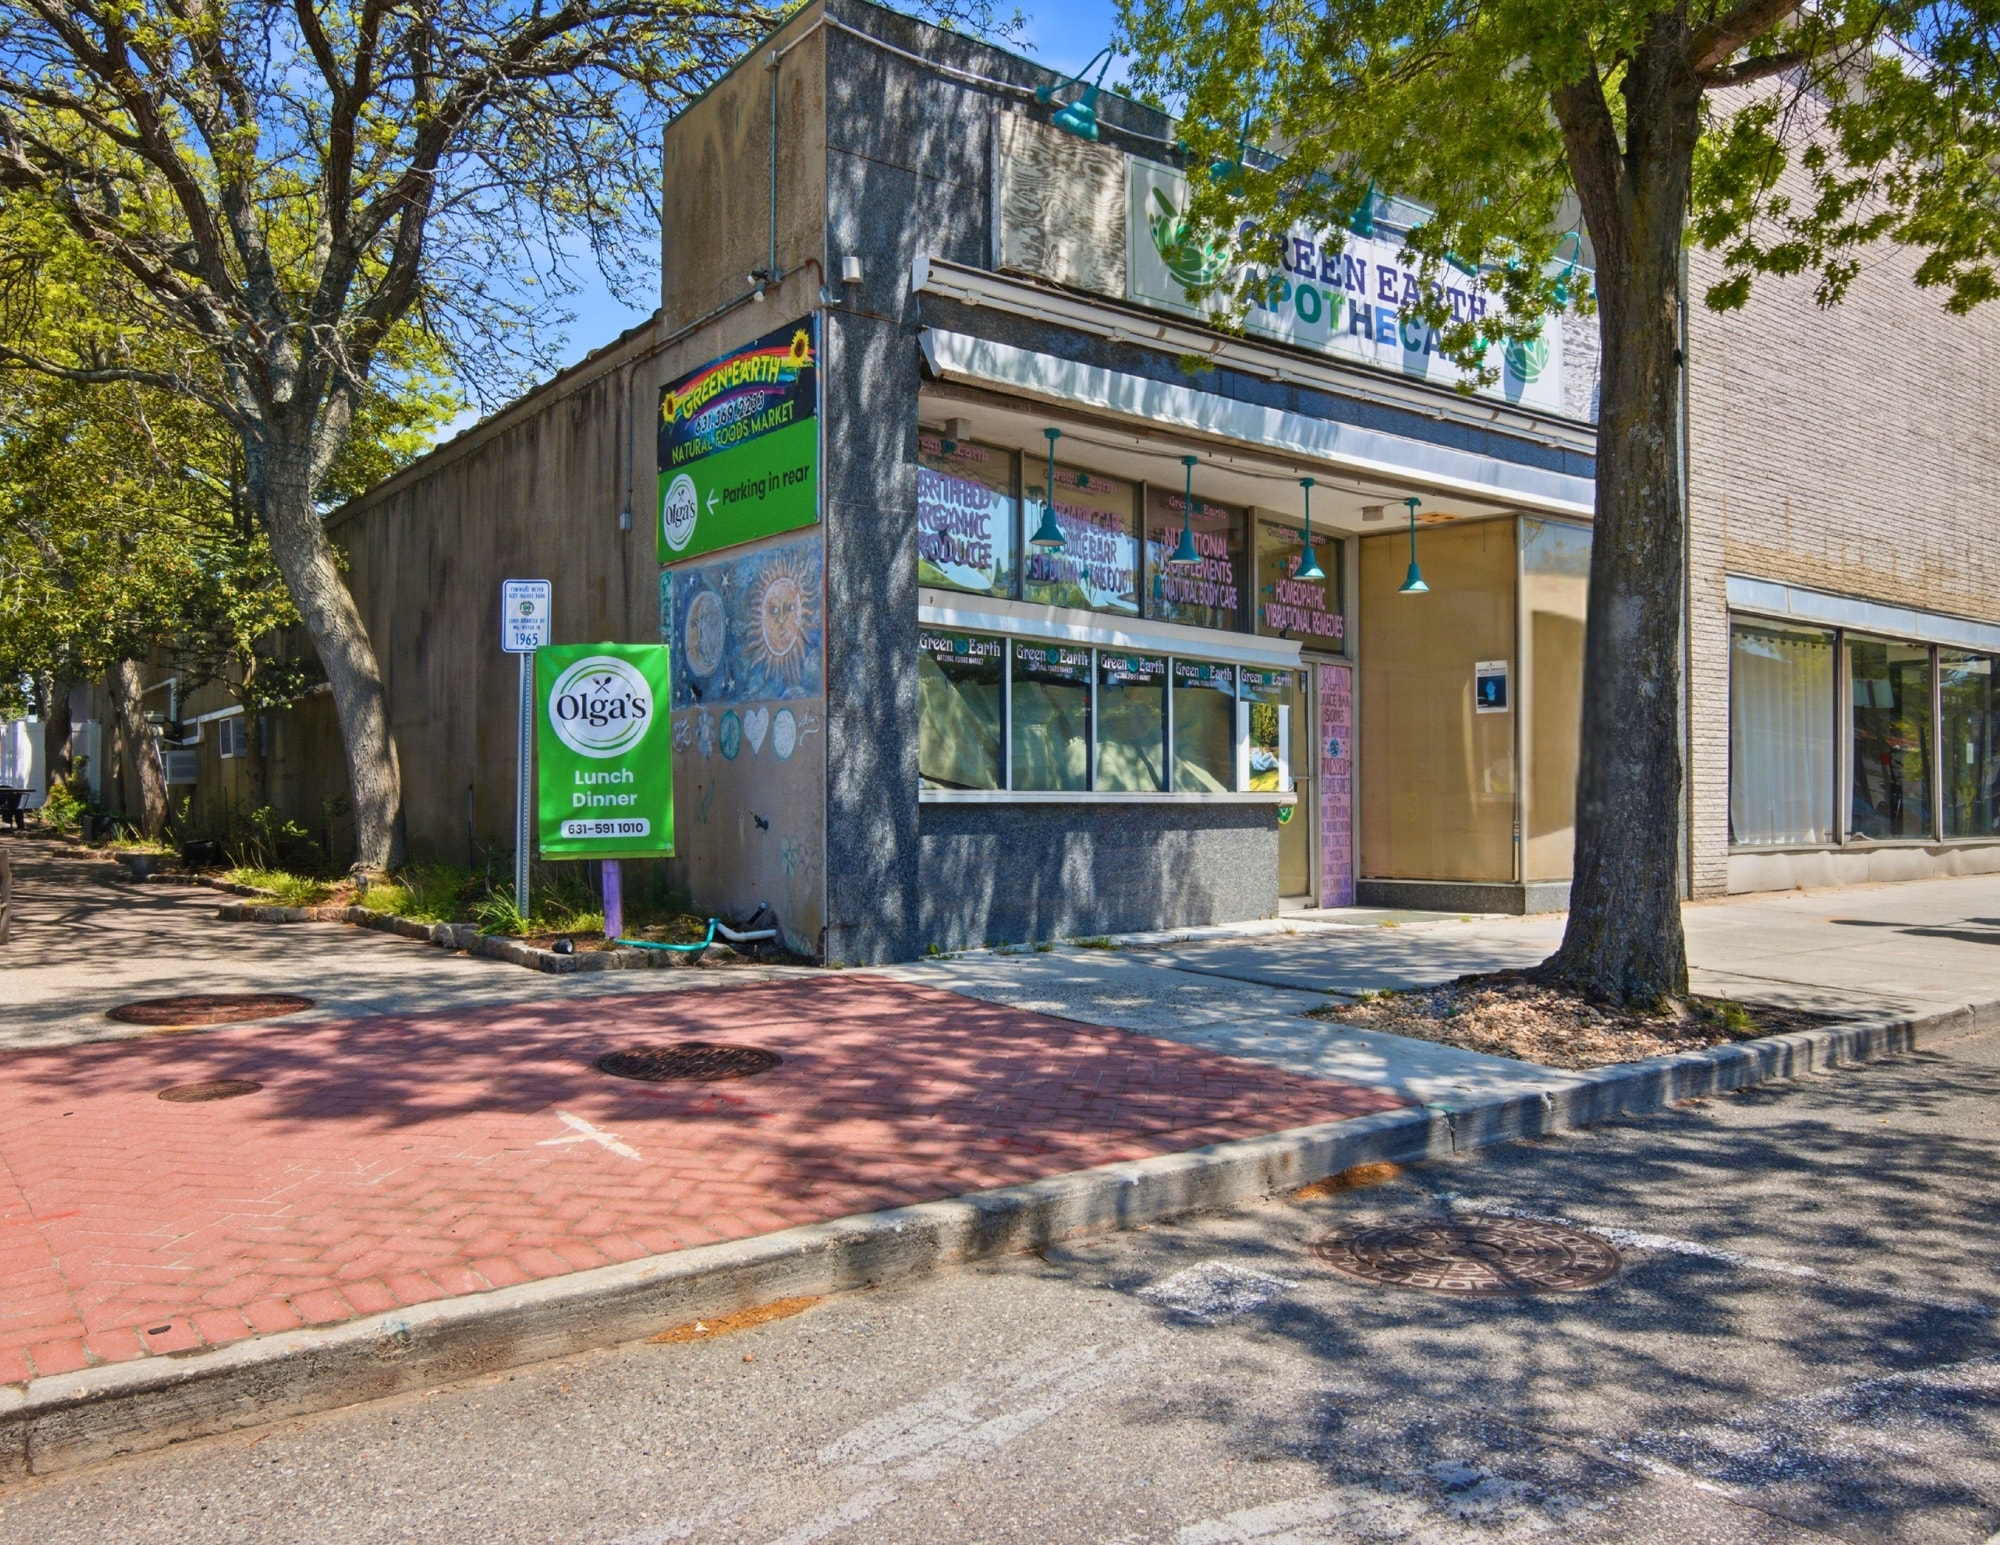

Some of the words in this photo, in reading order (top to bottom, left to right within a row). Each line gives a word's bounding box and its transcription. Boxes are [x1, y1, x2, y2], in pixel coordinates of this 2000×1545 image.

[1242, 268, 1489, 369] APOTHECAY
[681, 364, 731, 419] GREEN
[731, 355, 782, 387] EARTH
[695, 389, 765, 436] 631.369.2233
[672, 431, 713, 464] NATURAL
[715, 422, 750, 448] FOODS
[752, 400, 795, 435] MARKET
[722, 482, 766, 506] Parking
[768, 472, 780, 490] in
[782, 464, 811, 486] rear
[918, 470, 991, 509] ERTIFIED
[665, 500, 696, 527] Olga's
[918, 501, 991, 539] RGANIC
[1052, 500, 1096, 529] RGANIC
[918, 531, 992, 570] RODUCE
[1165, 526, 1228, 560] NUTIONAL
[1200, 582, 1218, 607] BODY
[1219, 586, 1238, 609] CARE
[1276, 579, 1326, 610] HOMEOPATHIC
[1265, 603, 1311, 633] VIBRATIONAL
[1312, 611, 1344, 639] REMEDIES
[515, 633, 538, 646] 1965
[919, 633, 953, 652] Green
[968, 638, 1001, 657] Earth
[1016, 644, 1046, 662] Green
[1059, 648, 1089, 667] Earth
[1101, 654, 1128, 670] Green
[1139, 657, 1165, 675] Earth
[1176, 662, 1200, 678] Green
[1209, 665, 1233, 681] Earth
[1241, 669, 1263, 684] Green
[1272, 672, 1293, 687] Earth
[556, 693, 647, 727] Olga's
[575, 768, 634, 785] Lunch
[1321, 758, 1351, 776] TRESSED?
[572, 790, 638, 808] Dinner
[568, 823, 615, 836] 631-591
[618, 822, 644, 834] 1010
